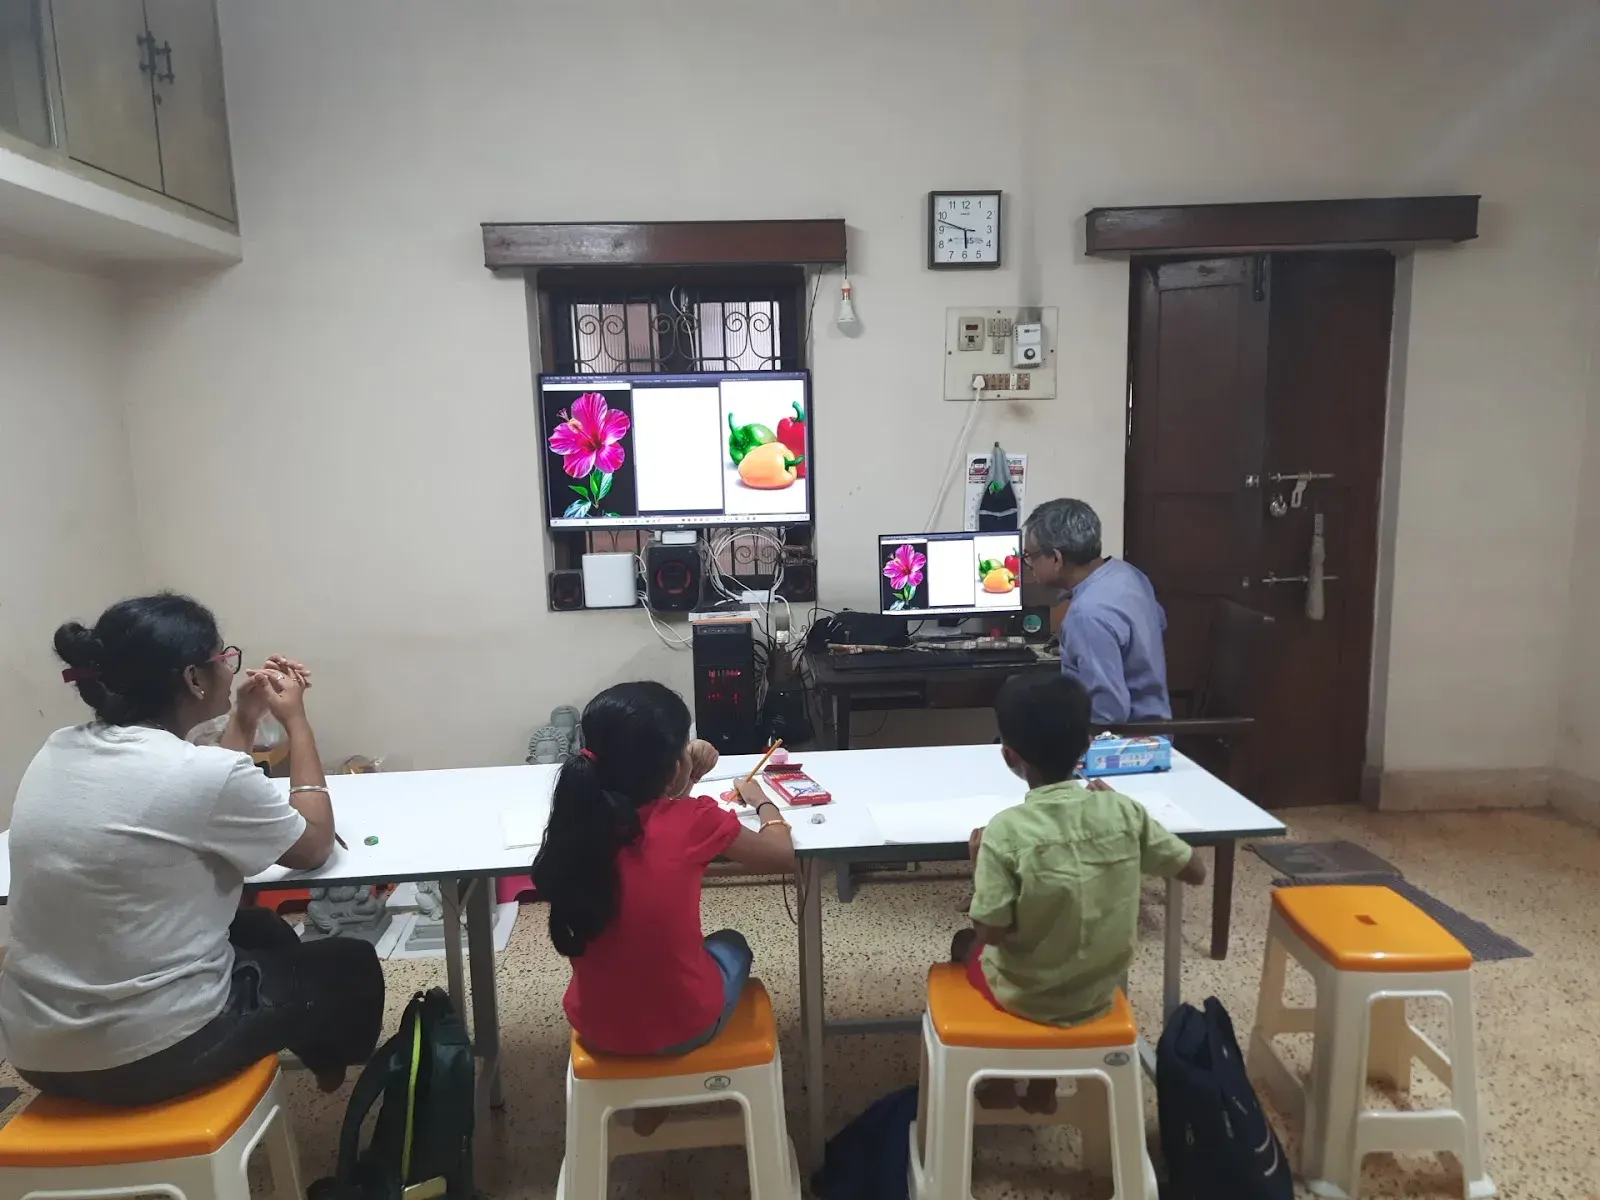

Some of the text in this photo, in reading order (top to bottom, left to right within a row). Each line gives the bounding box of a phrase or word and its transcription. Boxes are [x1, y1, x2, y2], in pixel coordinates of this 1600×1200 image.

[949, 201, 956, 209] 11
[962, 201, 970, 209] 12
[978, 201, 981, 209] 1
[938, 211, 947, 220] 10
[987, 211, 992, 219] 2
[939, 225, 944, 234] 9
[987, 225, 992, 234] 3
[939, 240, 944, 248] 8
[986, 240, 991, 248] 4
[949, 251, 954, 259] 7
[962, 251, 967, 259] 6
[976, 251, 981, 259] 5
